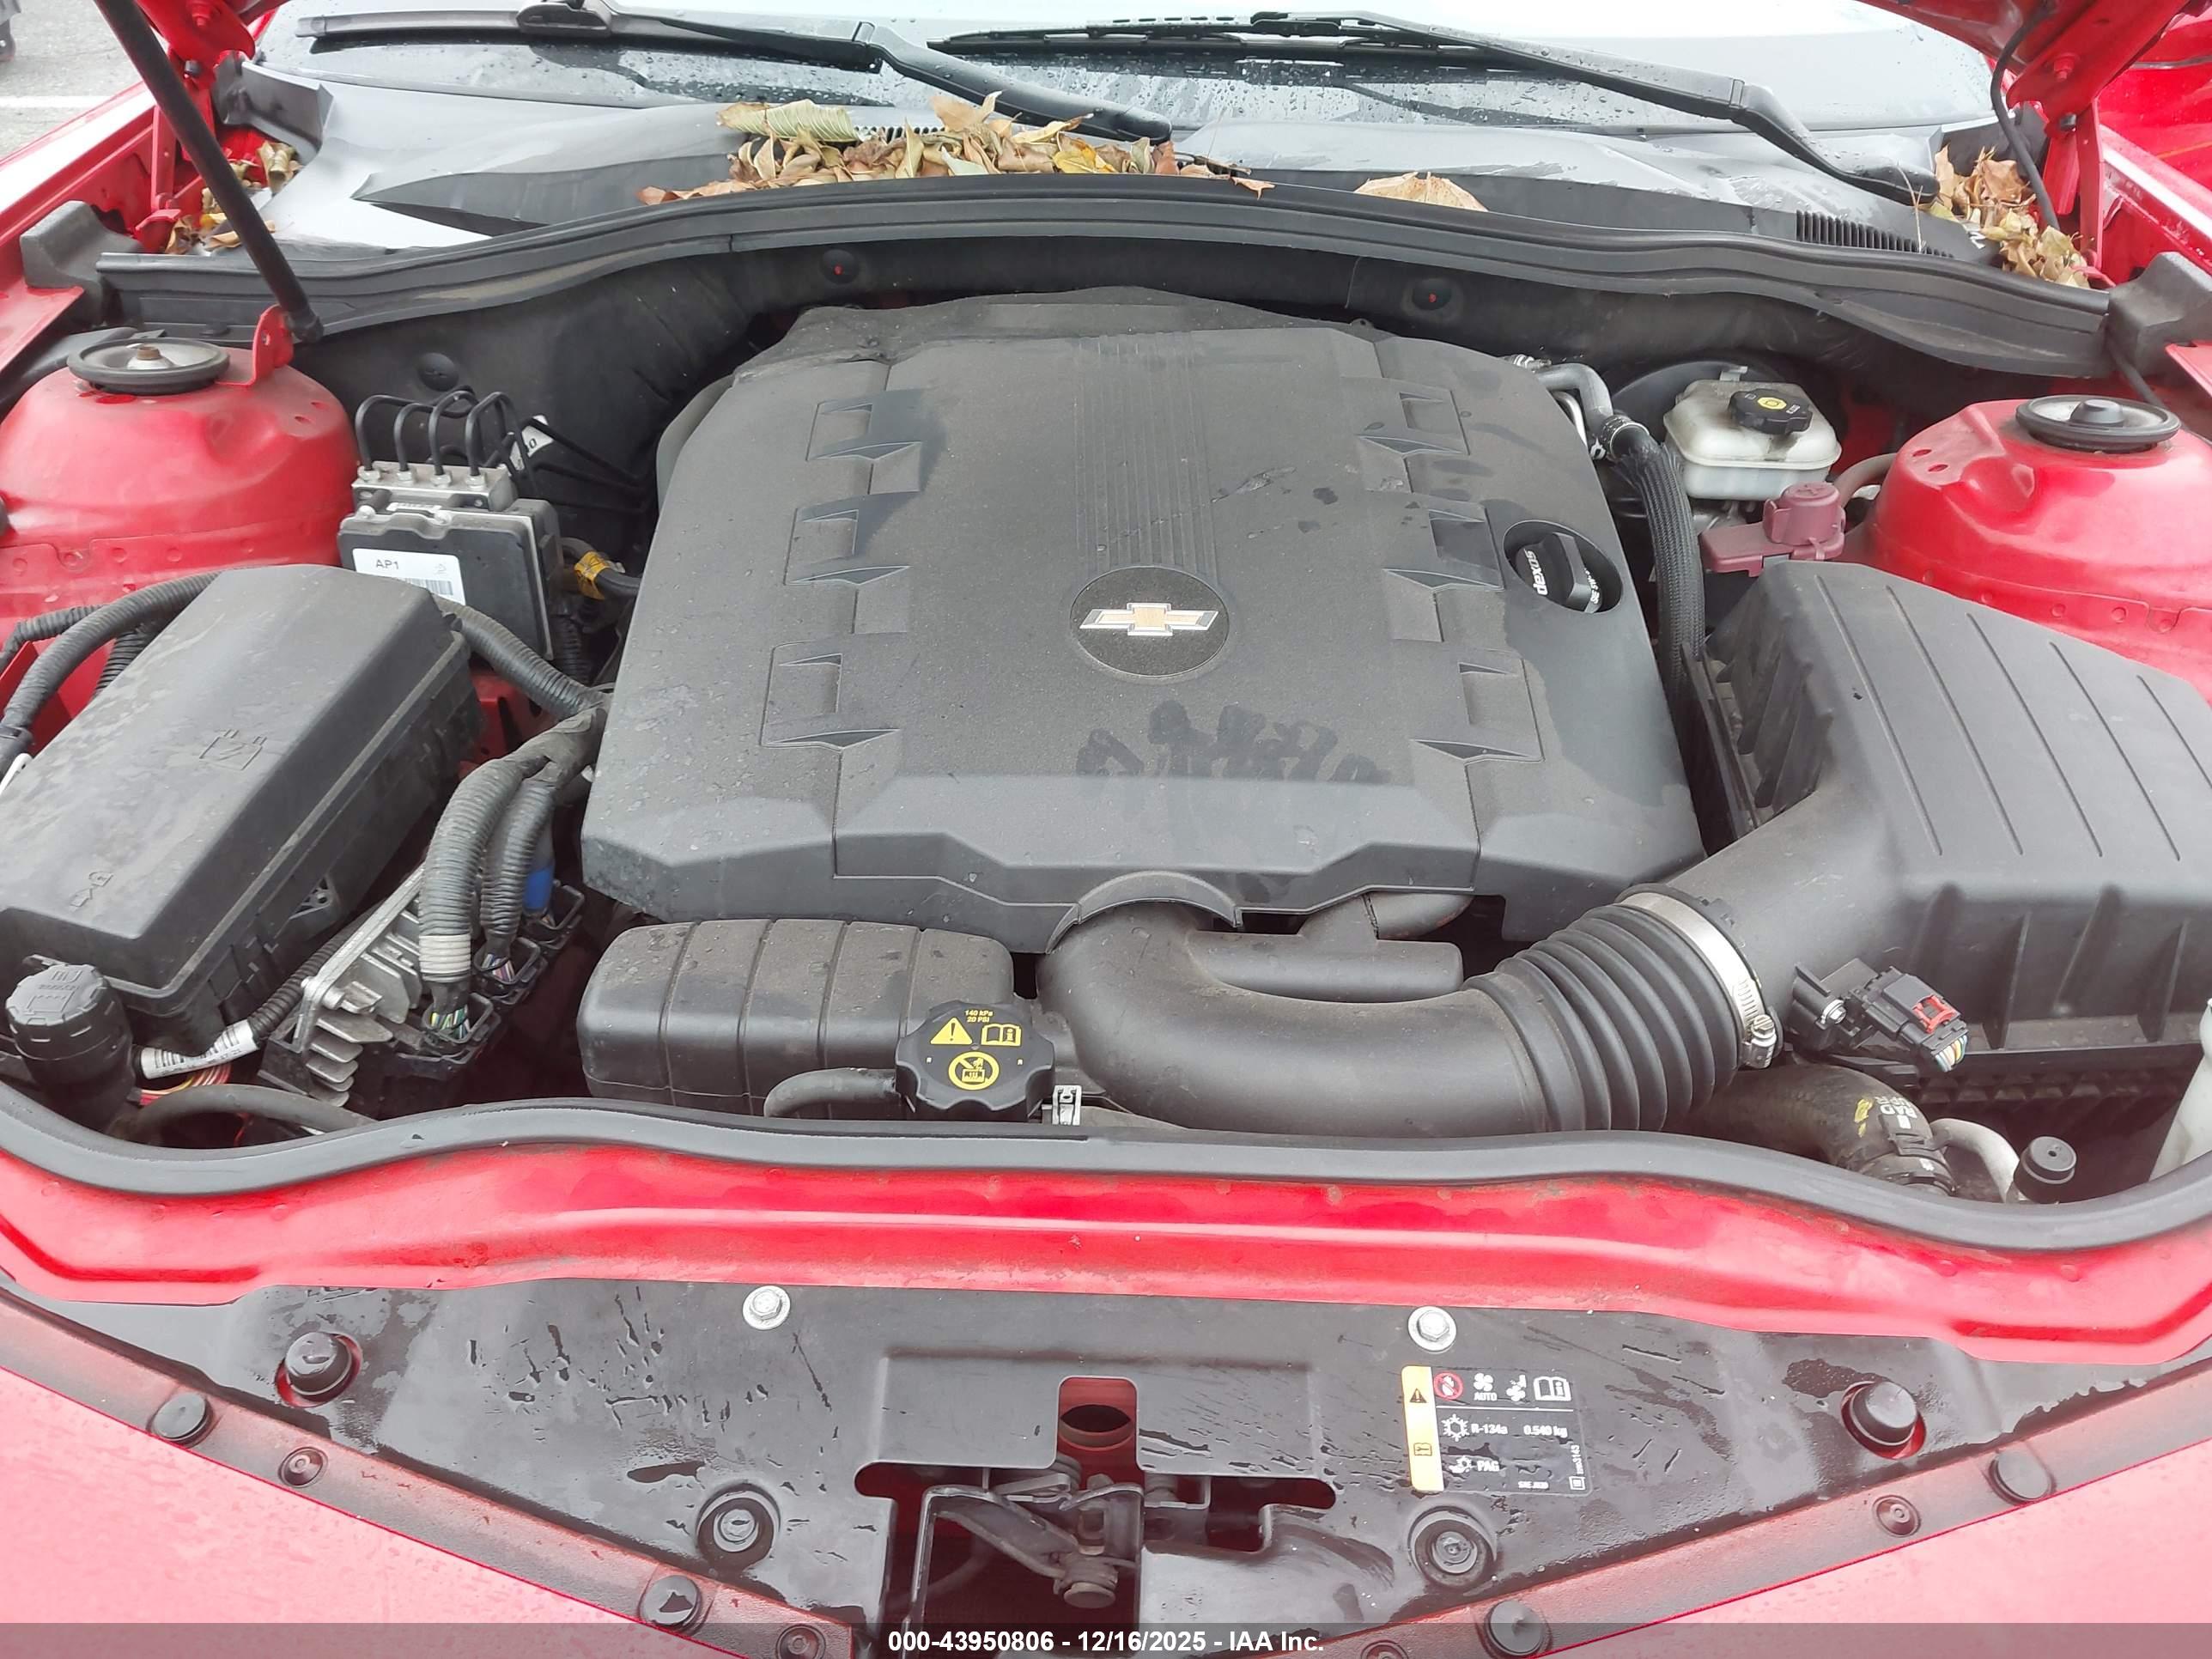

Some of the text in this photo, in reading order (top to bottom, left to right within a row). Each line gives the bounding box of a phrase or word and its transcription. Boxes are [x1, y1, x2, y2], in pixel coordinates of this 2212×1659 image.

[376, 559, 399, 570] AP1
[1523, 547, 1548, 596] dexos
[1474, 1391, 1498, 1401] AUTO
[1471, 1423, 1509, 1435] R-134a
[1553, 1425, 1568, 1438] kg
[1477, 1460, 1500, 1472] PAG
